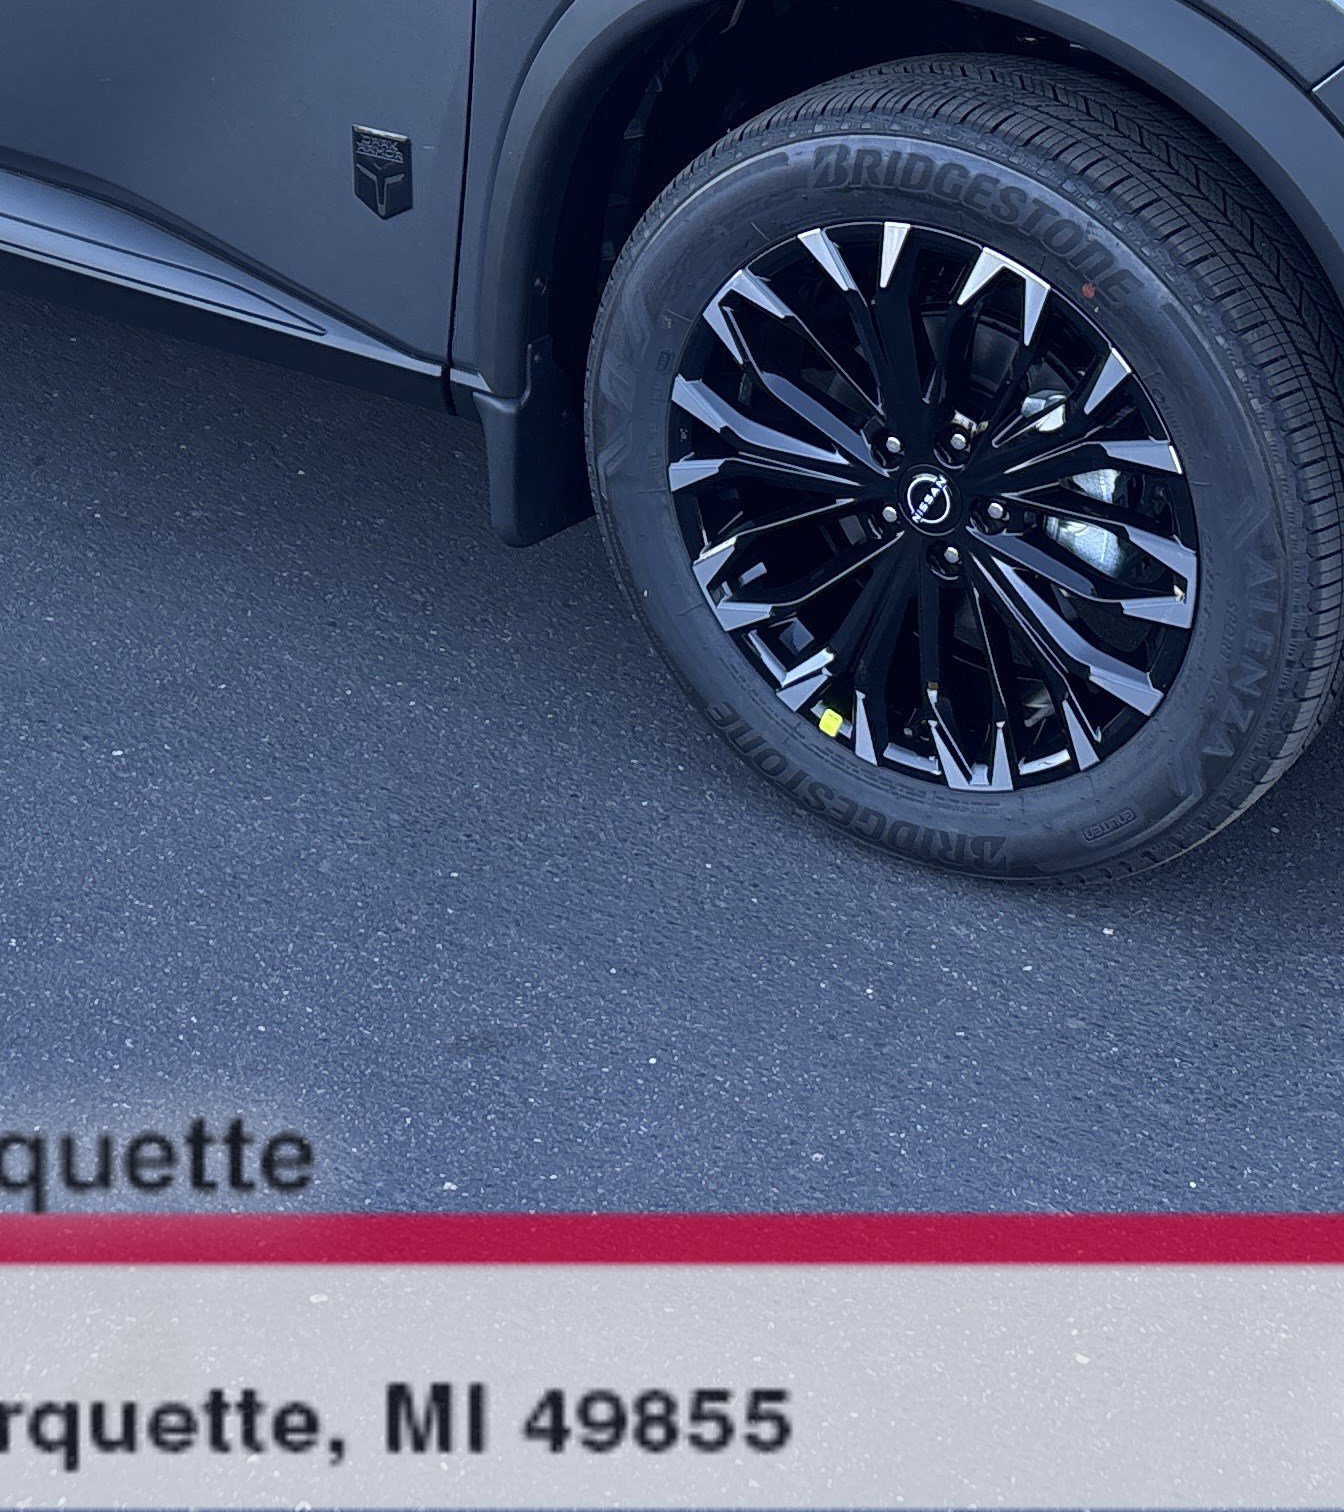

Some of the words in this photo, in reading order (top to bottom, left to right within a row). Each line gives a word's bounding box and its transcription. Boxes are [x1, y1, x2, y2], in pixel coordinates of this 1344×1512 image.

[813, 142, 1146, 304] BRIDGESTONE
[911, 473, 947, 524] NISSAN
[706, 700, 1008, 873] BRIDGESTONE
